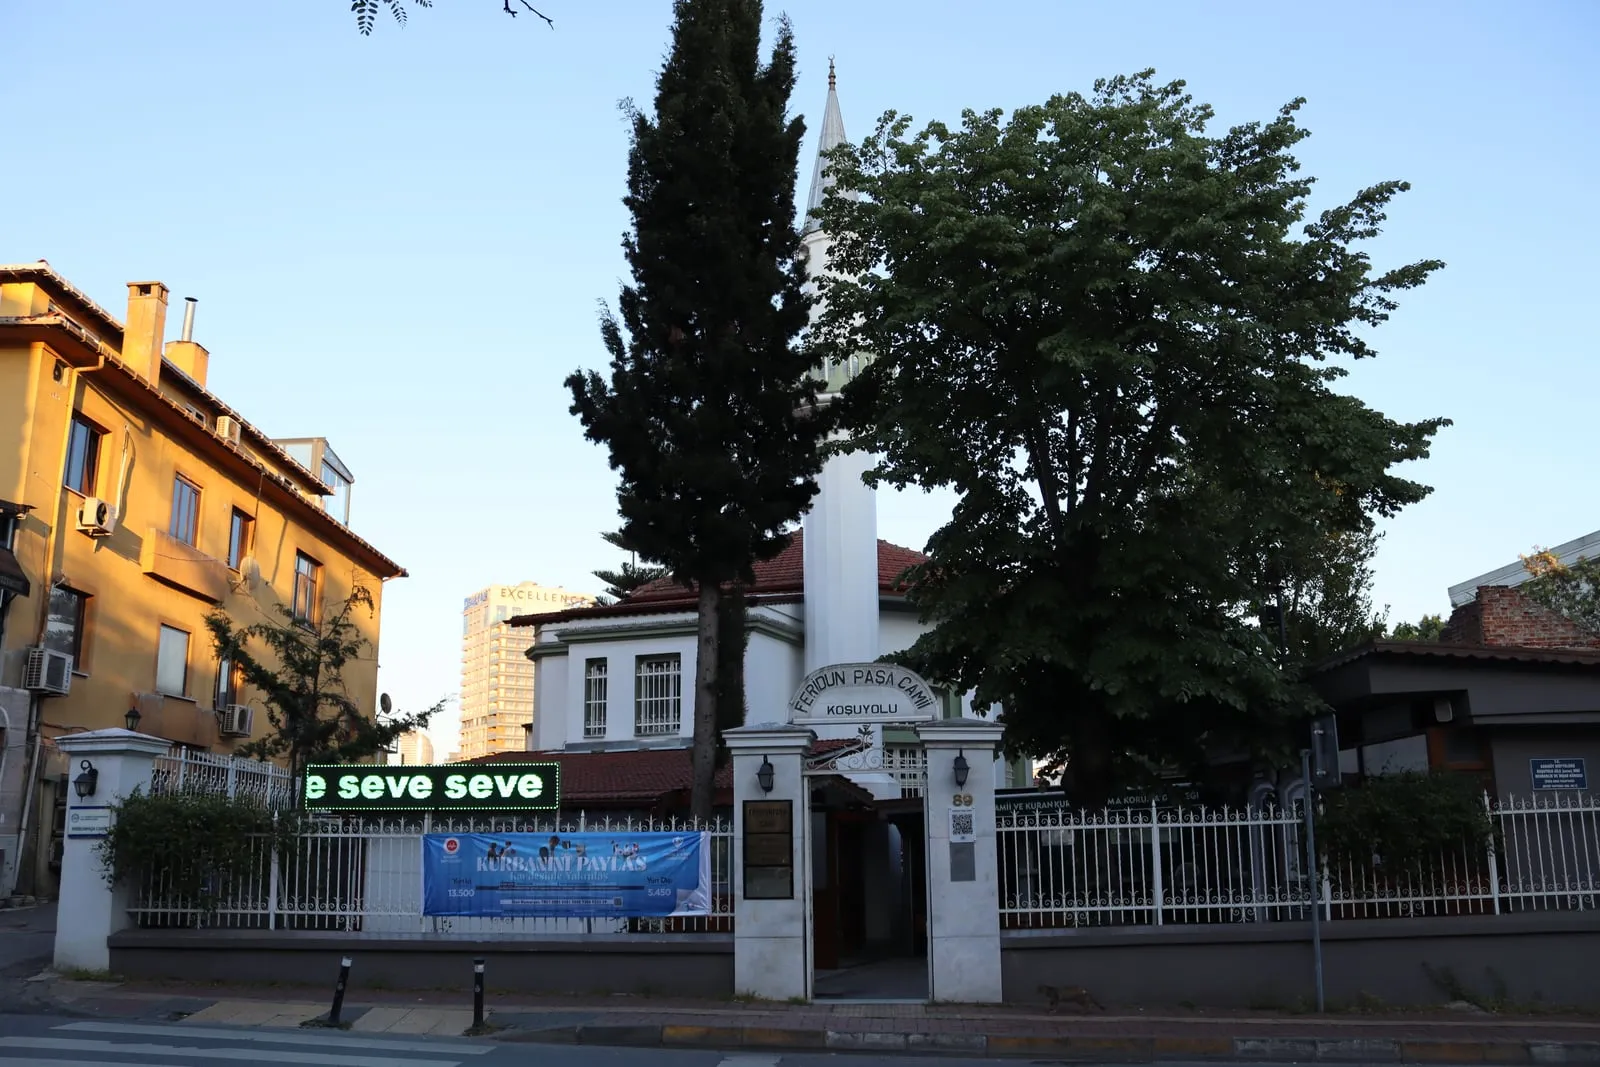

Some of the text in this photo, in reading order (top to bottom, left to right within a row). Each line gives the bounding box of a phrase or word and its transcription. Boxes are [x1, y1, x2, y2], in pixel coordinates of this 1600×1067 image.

[794, 669, 934, 713] FERİDUN PAŞA CAMİİ
[826, 703, 898, 716] KOŞUYOLU
[337, 774, 433, 800] seve
[444, 773, 543, 799] seve
